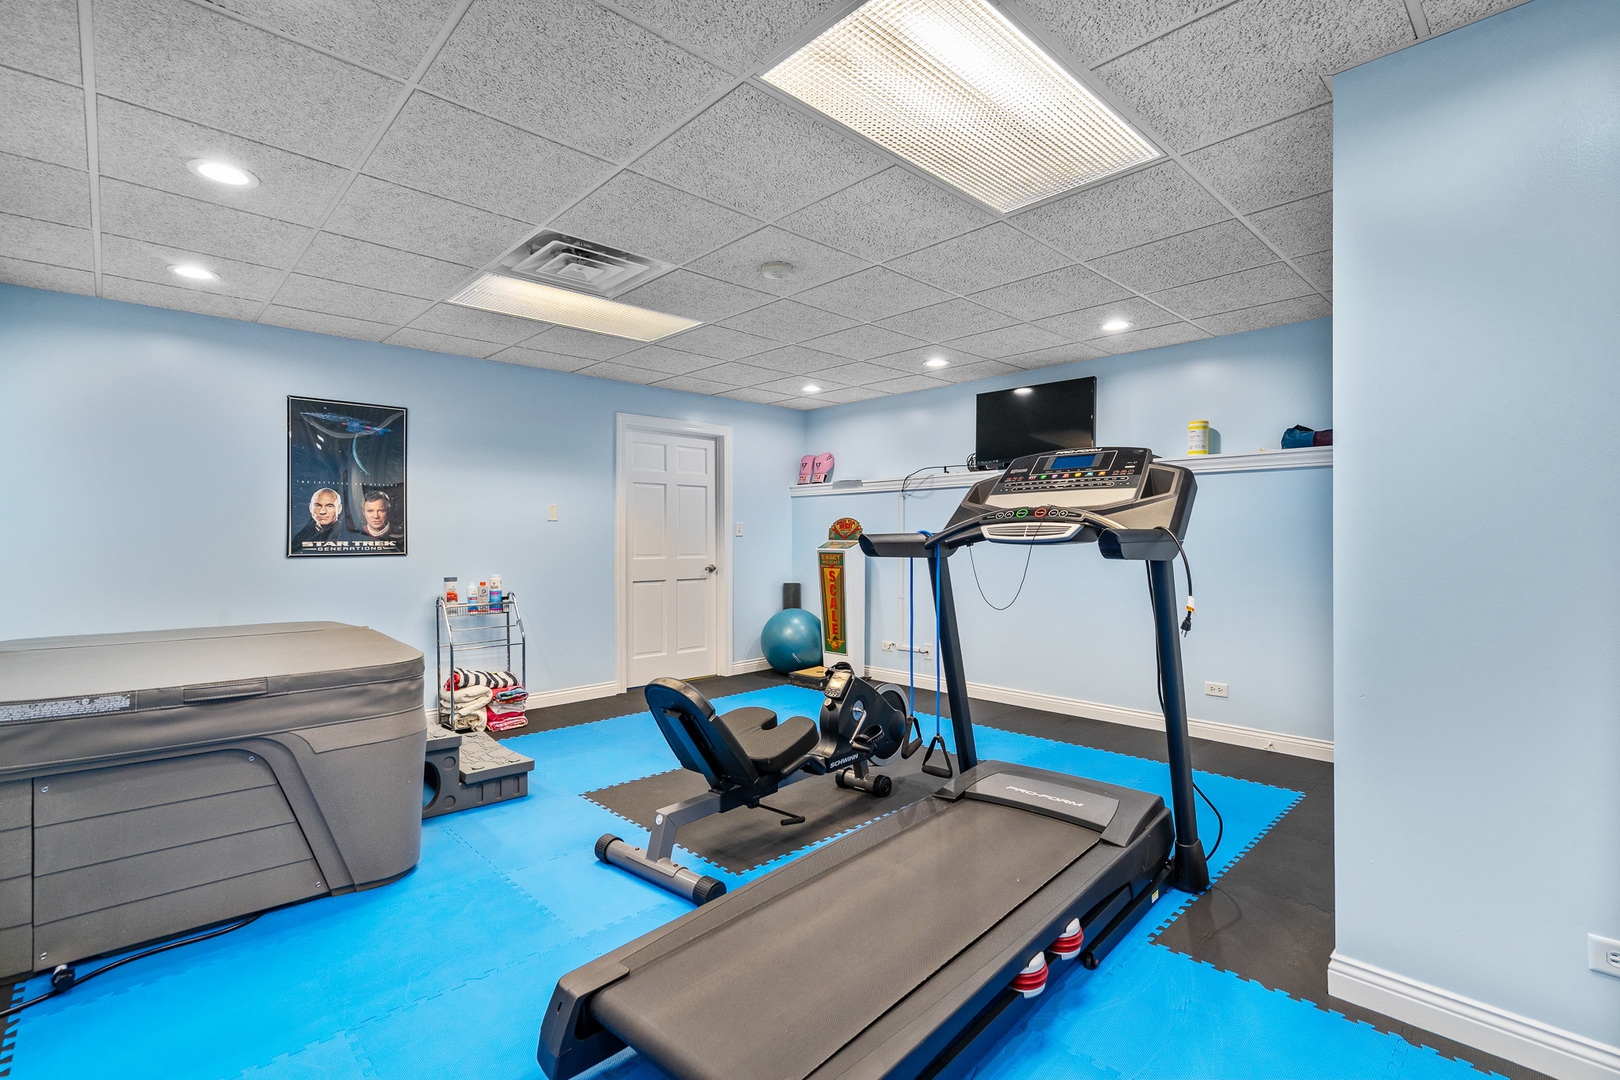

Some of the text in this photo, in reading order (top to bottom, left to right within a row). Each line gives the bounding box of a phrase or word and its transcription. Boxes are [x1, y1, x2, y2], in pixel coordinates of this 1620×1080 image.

[829, 570, 838, 634] SCALE
[830, 753, 859, 769] SCHWINN
[1005, 785, 1084, 807] PRO-FORM
